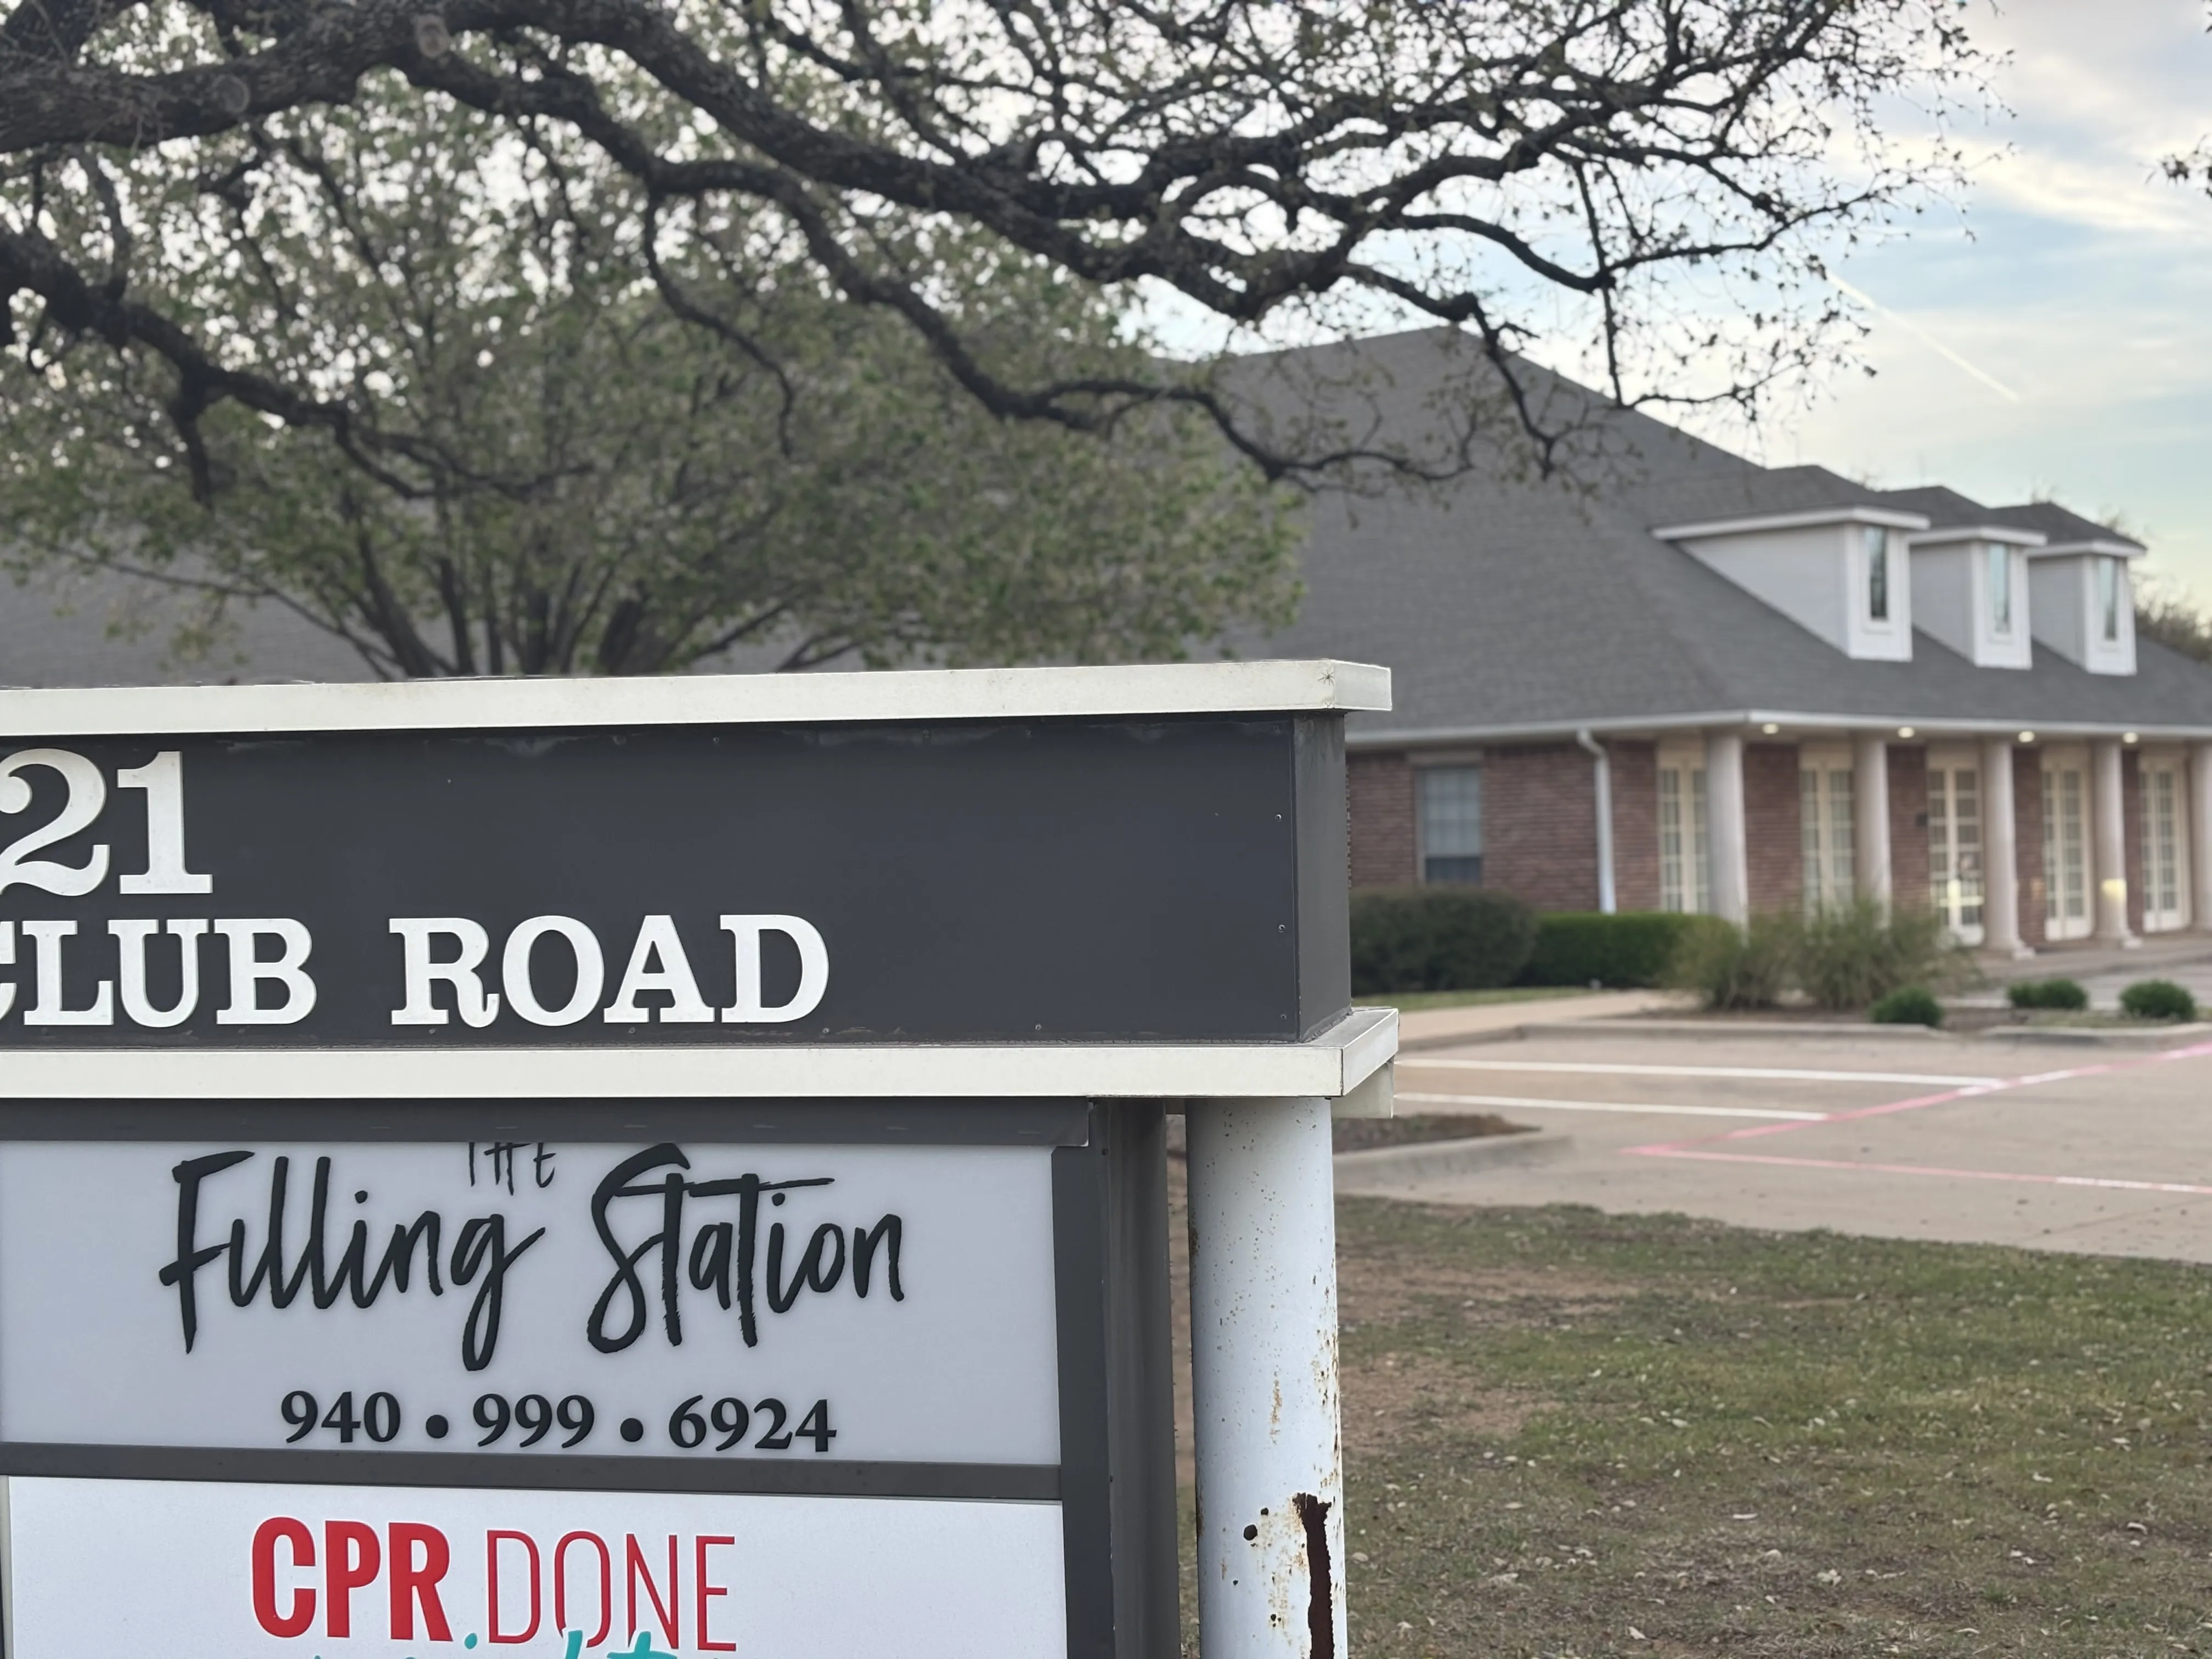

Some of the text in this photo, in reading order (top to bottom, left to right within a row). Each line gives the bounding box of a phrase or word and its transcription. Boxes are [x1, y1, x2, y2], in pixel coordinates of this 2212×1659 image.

[0, 748, 213, 896] 21
[0, 914, 830, 1029] LUB ROAD
[159, 1150, 546, 1372] Filling
